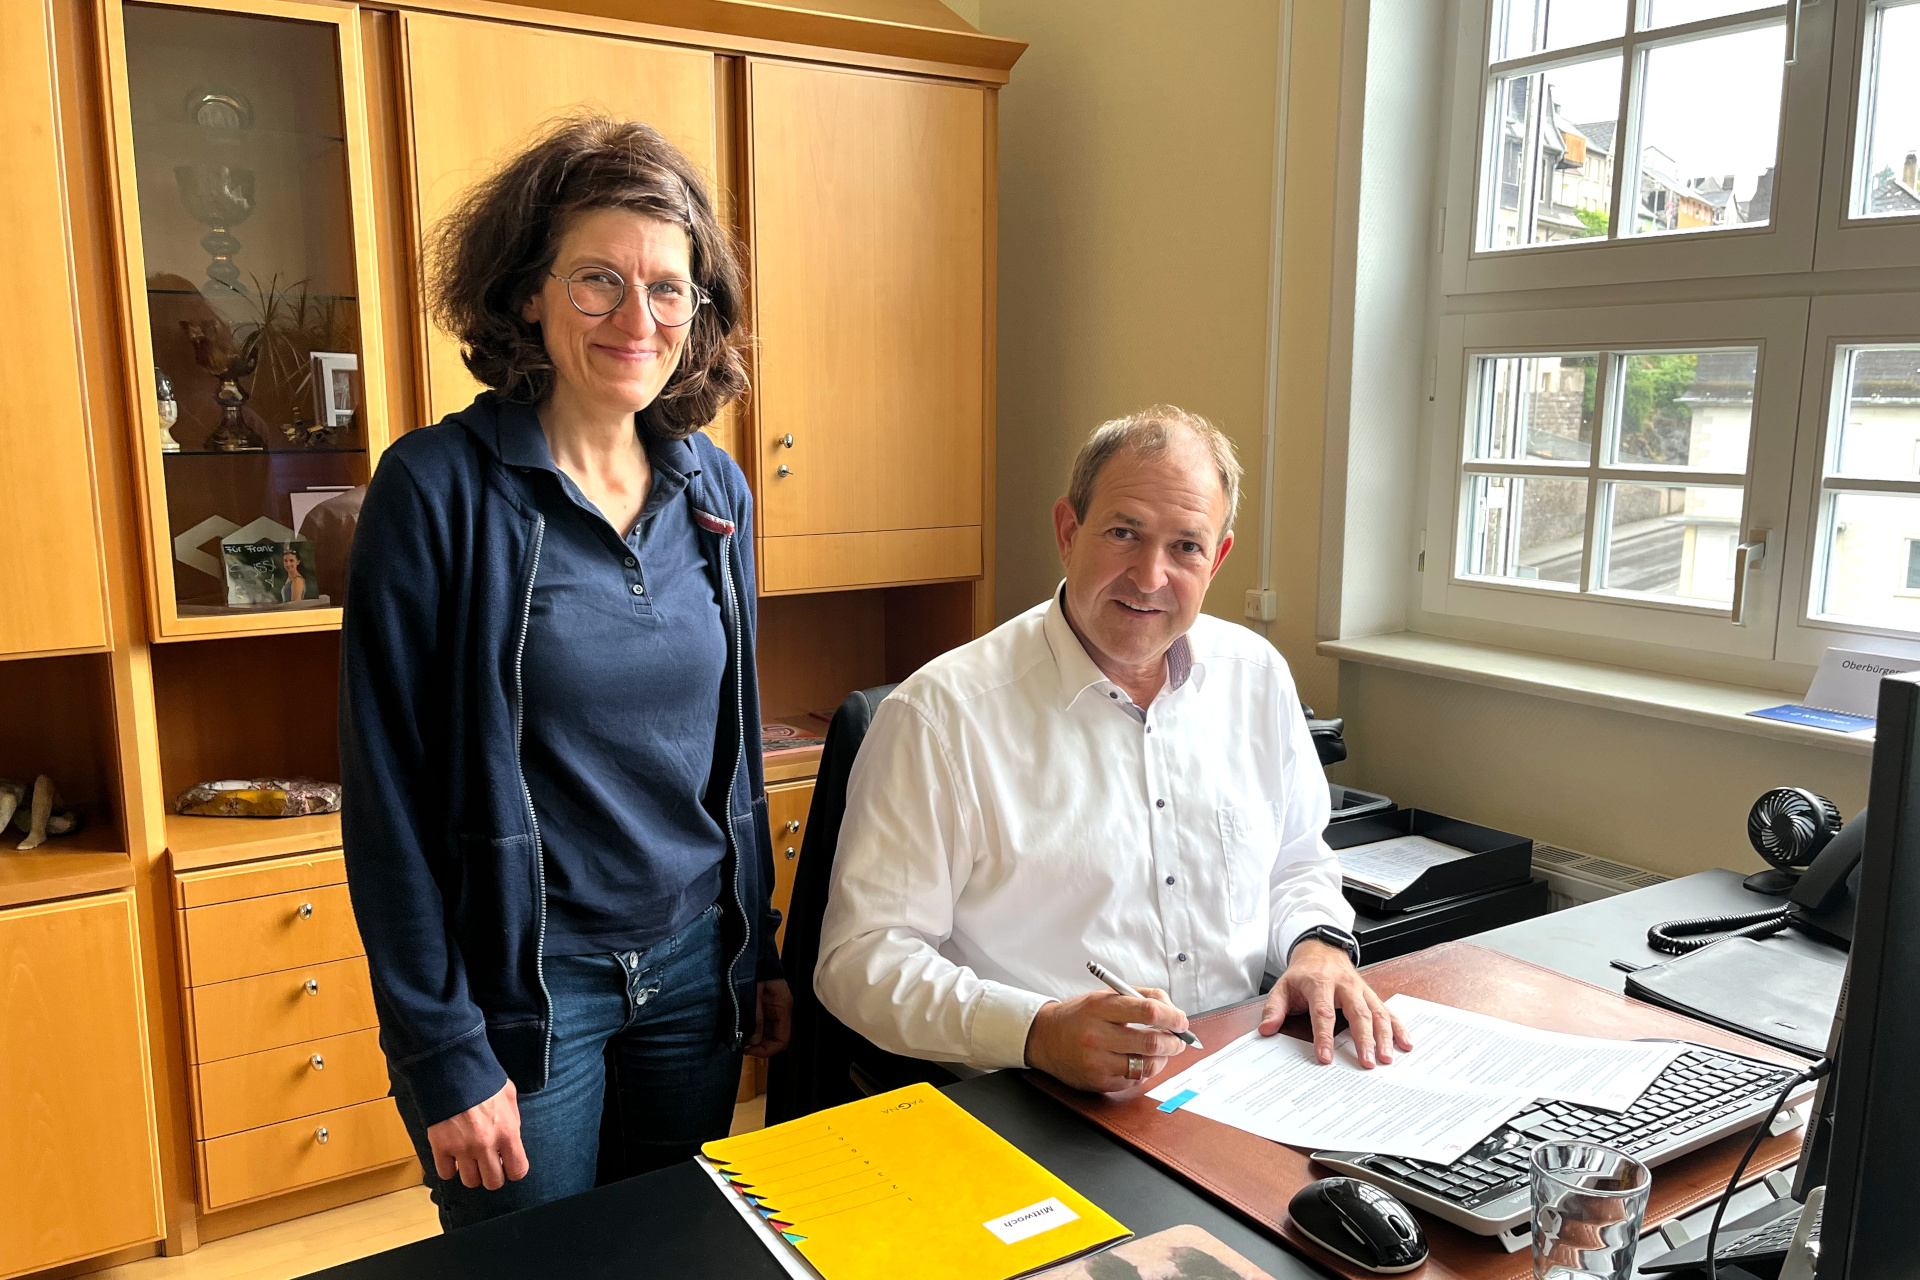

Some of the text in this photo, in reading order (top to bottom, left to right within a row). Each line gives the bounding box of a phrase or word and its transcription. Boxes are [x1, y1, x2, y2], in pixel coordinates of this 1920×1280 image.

[224, 545, 274, 554] Für Frank
[881, 1099, 924, 1114] PAGNA
[1003, 1205, 1054, 1228] Mittwoch
